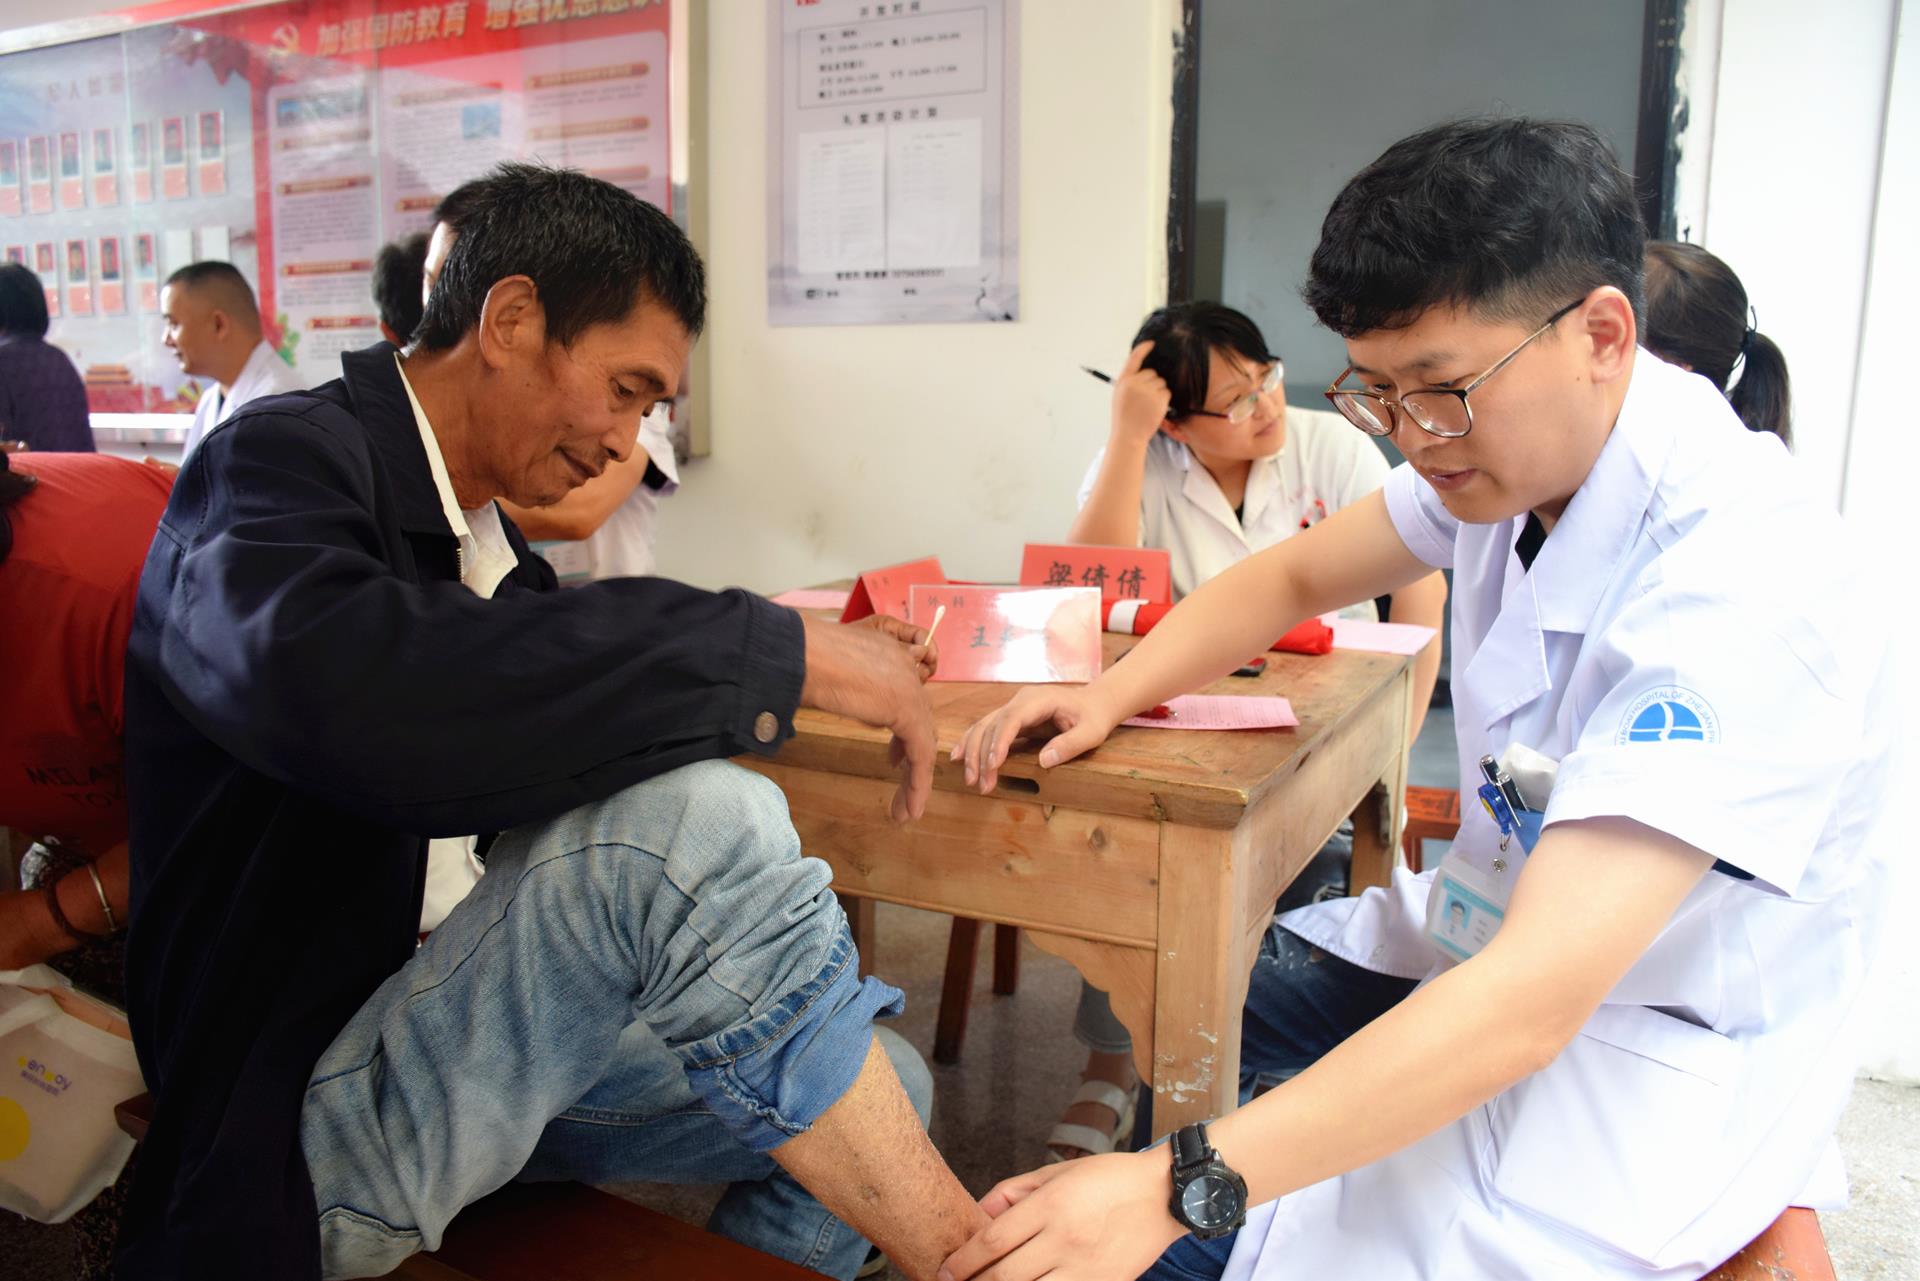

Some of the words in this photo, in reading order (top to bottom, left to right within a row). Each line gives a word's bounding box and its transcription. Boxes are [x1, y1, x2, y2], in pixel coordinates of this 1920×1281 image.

[317, 2, 468, 57] 加强国防教育
